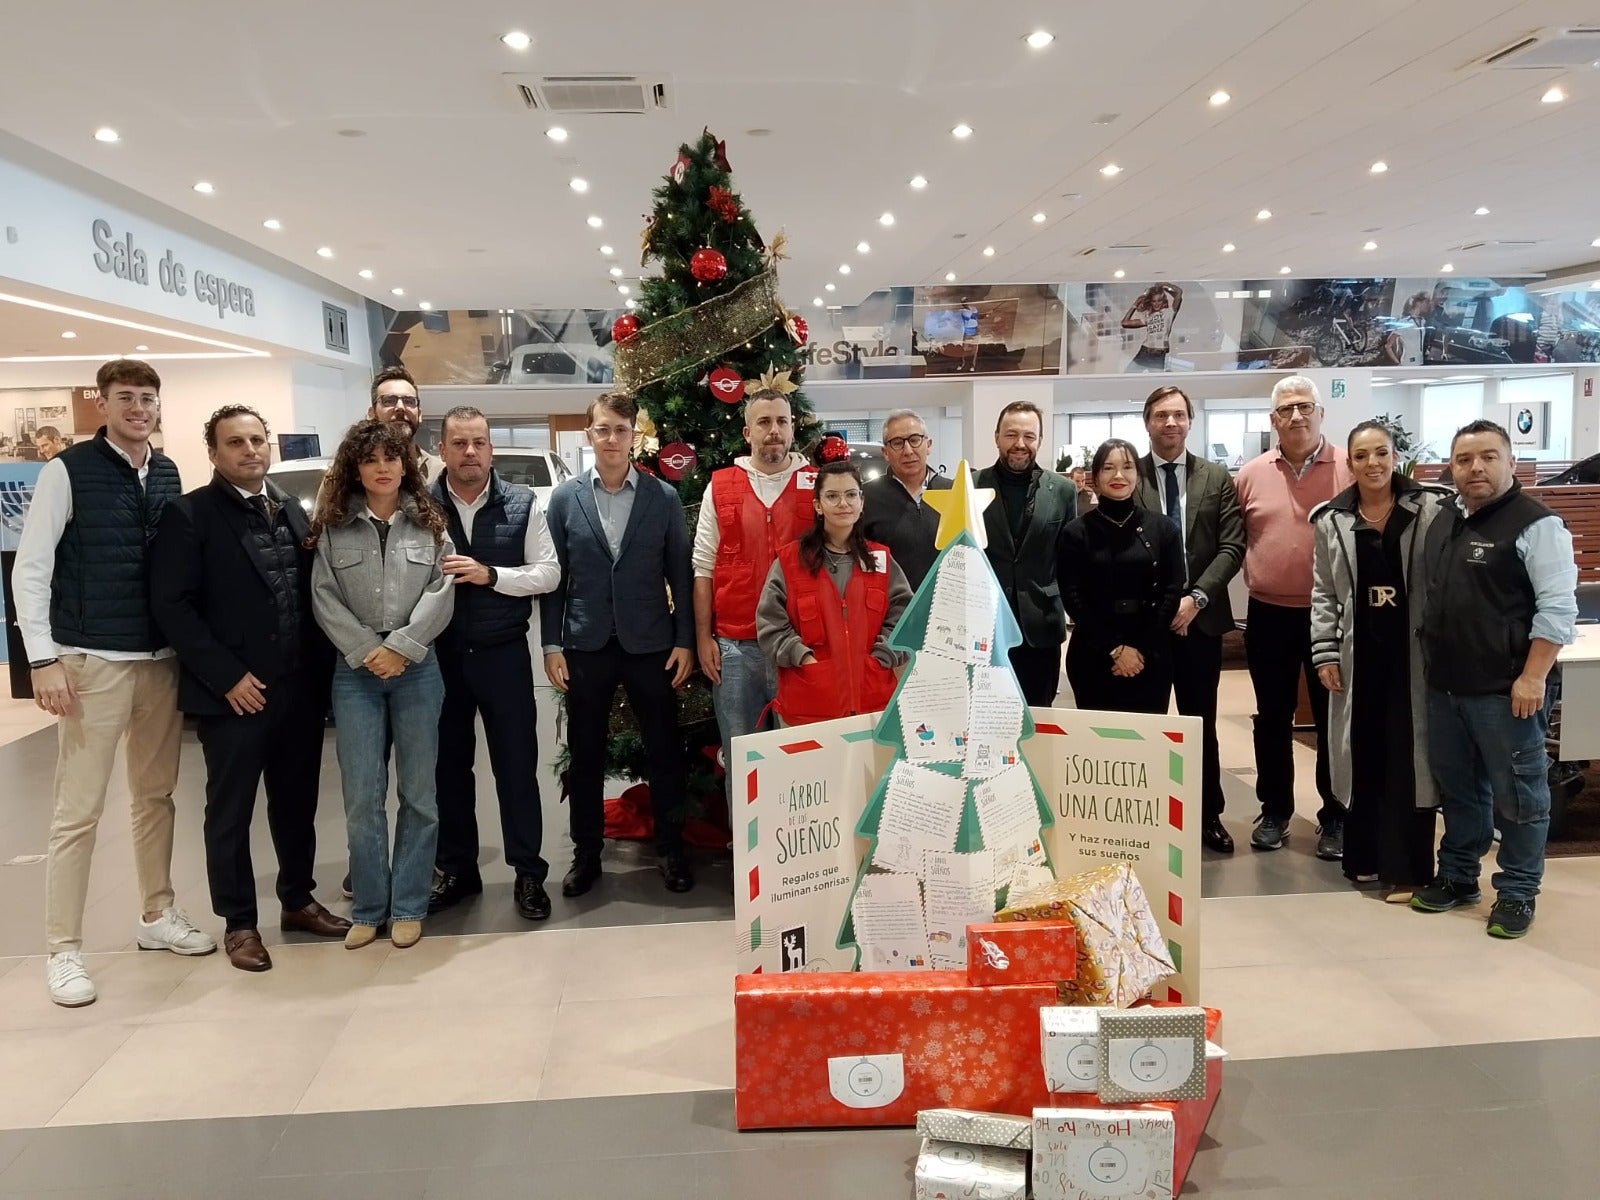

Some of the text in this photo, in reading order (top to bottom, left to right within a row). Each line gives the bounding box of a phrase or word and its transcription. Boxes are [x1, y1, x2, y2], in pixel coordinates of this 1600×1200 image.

[92, 218, 256, 319] Sala de espera
[83, 389, 100, 400] BM
[1065, 754, 1148, 789] ¡SOLICITA
[778, 780, 830, 813] EL ÁRBOL
[1059, 792, 1098, 821] UNA
[1104, 796, 1160, 827] CARTA!
[788, 813, 807, 826] DE LOS
[775, 816, 841, 864] SUEÑOS
[1069, 833, 1150, 849] Y haz realidad
[1079, 848, 1140, 861] sus sueños
[771, 875, 850, 903] iluminan sonrisas
[782, 865, 839, 886] Regalos que
